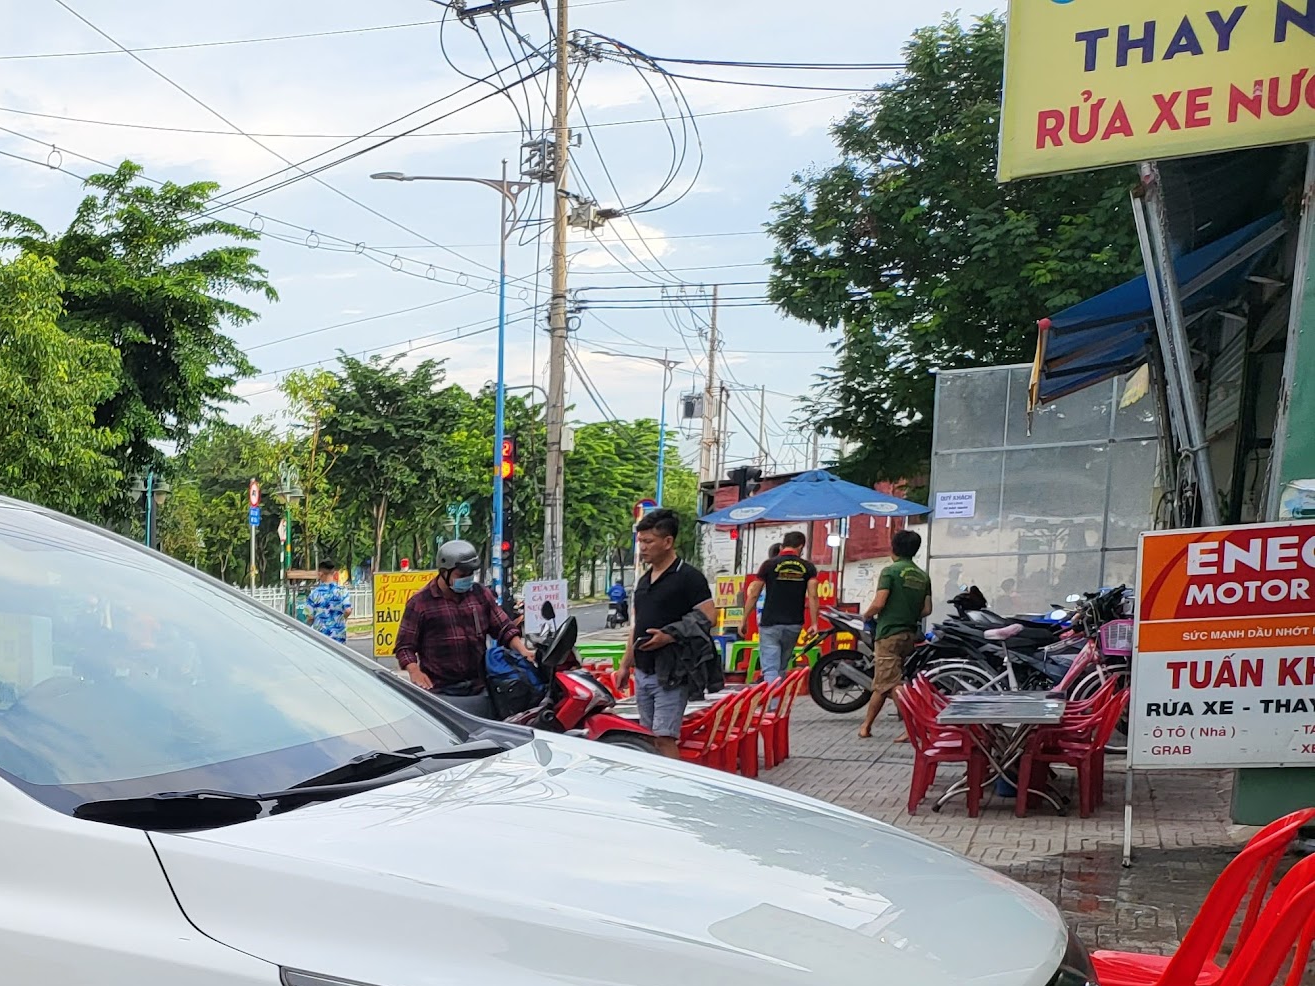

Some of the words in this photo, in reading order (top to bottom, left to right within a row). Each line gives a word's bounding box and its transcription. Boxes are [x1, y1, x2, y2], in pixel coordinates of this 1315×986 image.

[1075, 5, 1247, 72] THAY
[1036, 90, 1133, 149] RỬA
[1148, 87, 1213, 134] XE
[1185, 578, 1311, 606] MOTOR
[376, 607, 401, 623] HÀU
[376, 628, 393, 646] ỐC
[1182, 630, 1208, 641] SỨC
[1210, 630, 1245, 641] MẠNH
[1247, 626, 1273, 638] DẦU
[1275, 625, 1310, 636] NHỚT
[1167, 653, 1264, 689] TUẤN
[1146, 699, 1194, 717] RỬA
[1201, 700, 1234, 716] XE
[1152, 726, 1163, 738] Ô
[1166, 725, 1186, 738] TÔ
[1151, 745, 1192, 756] GRAB
